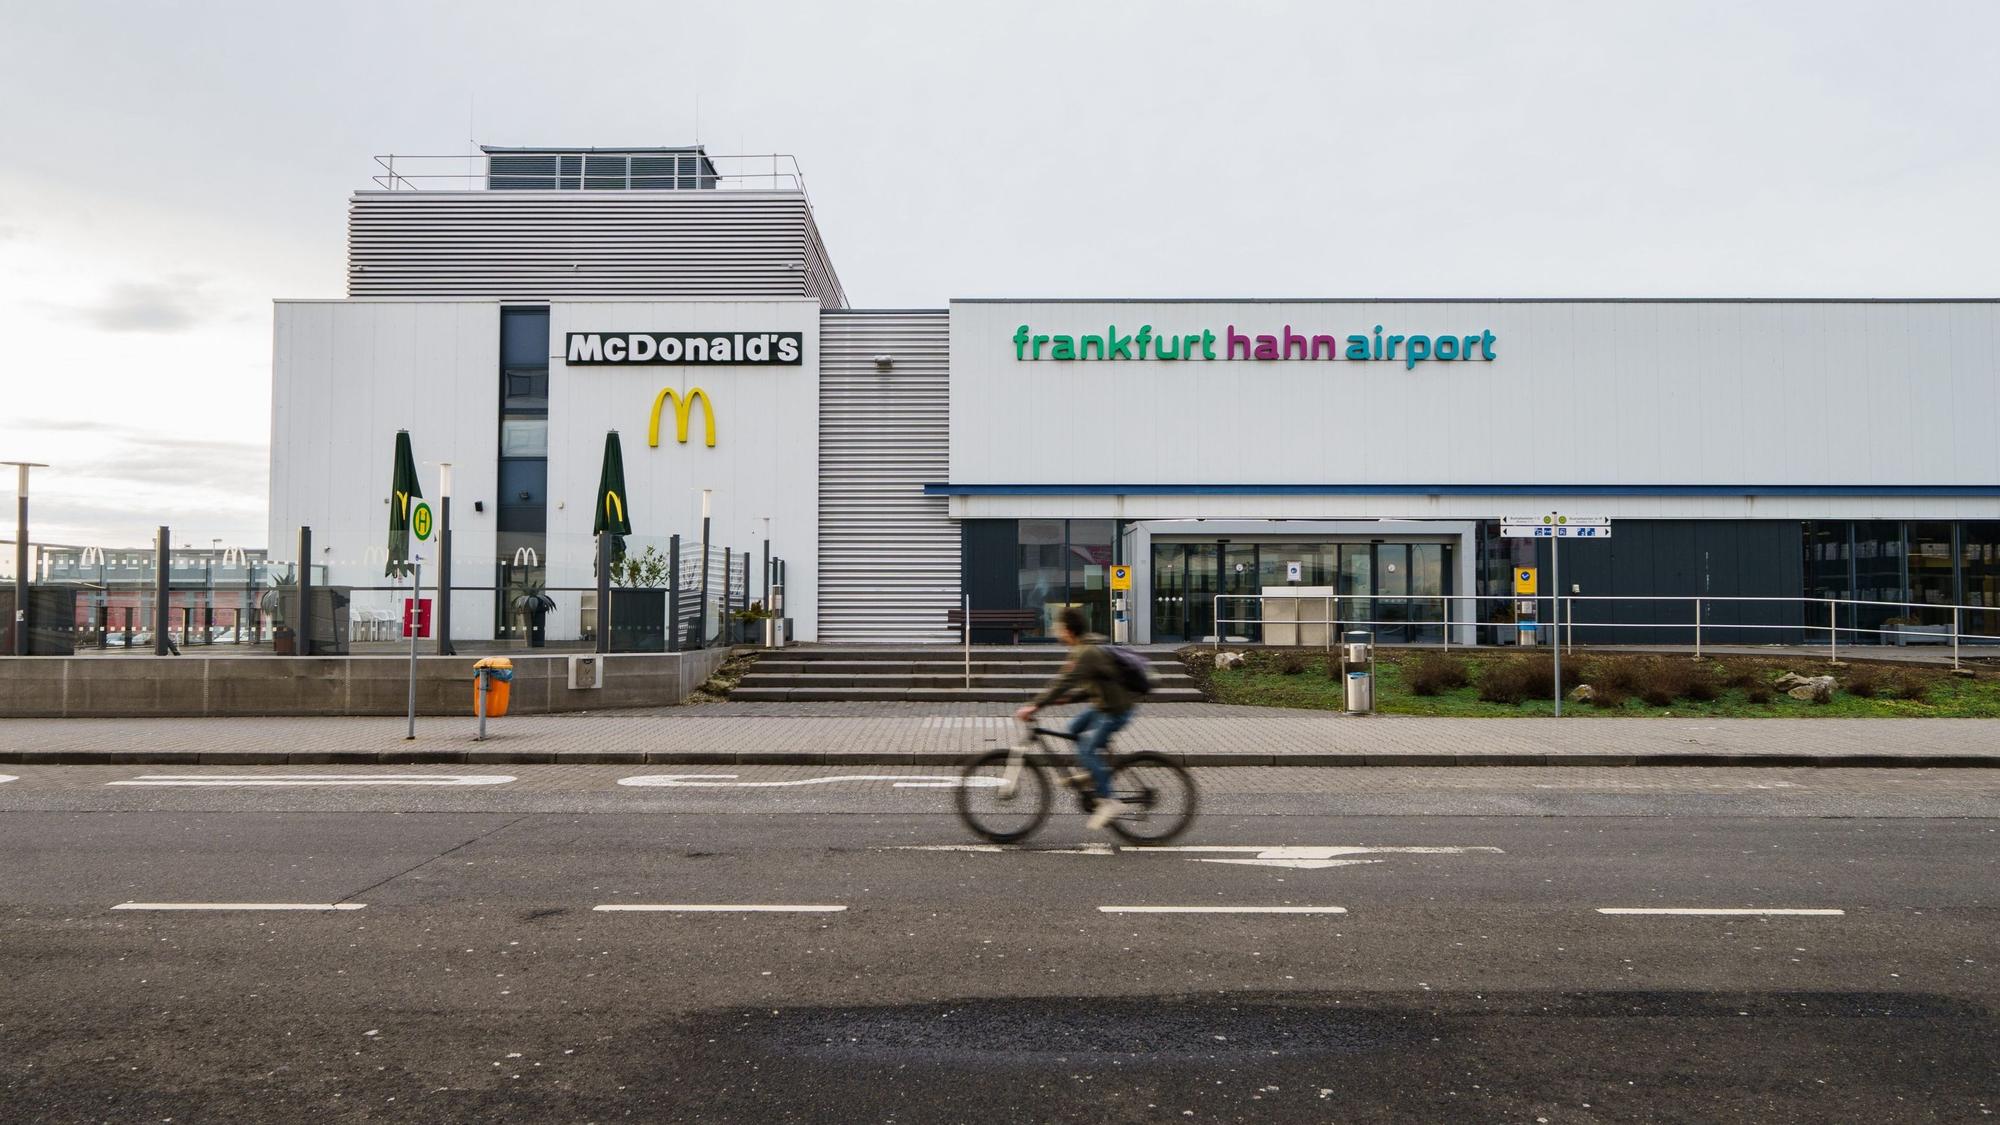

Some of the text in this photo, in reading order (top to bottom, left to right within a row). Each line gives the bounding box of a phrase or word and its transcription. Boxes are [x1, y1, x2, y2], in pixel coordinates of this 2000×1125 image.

[568, 334, 799, 361] McDonald's
[1013, 325, 1497, 370] frankfurt hahn airport
